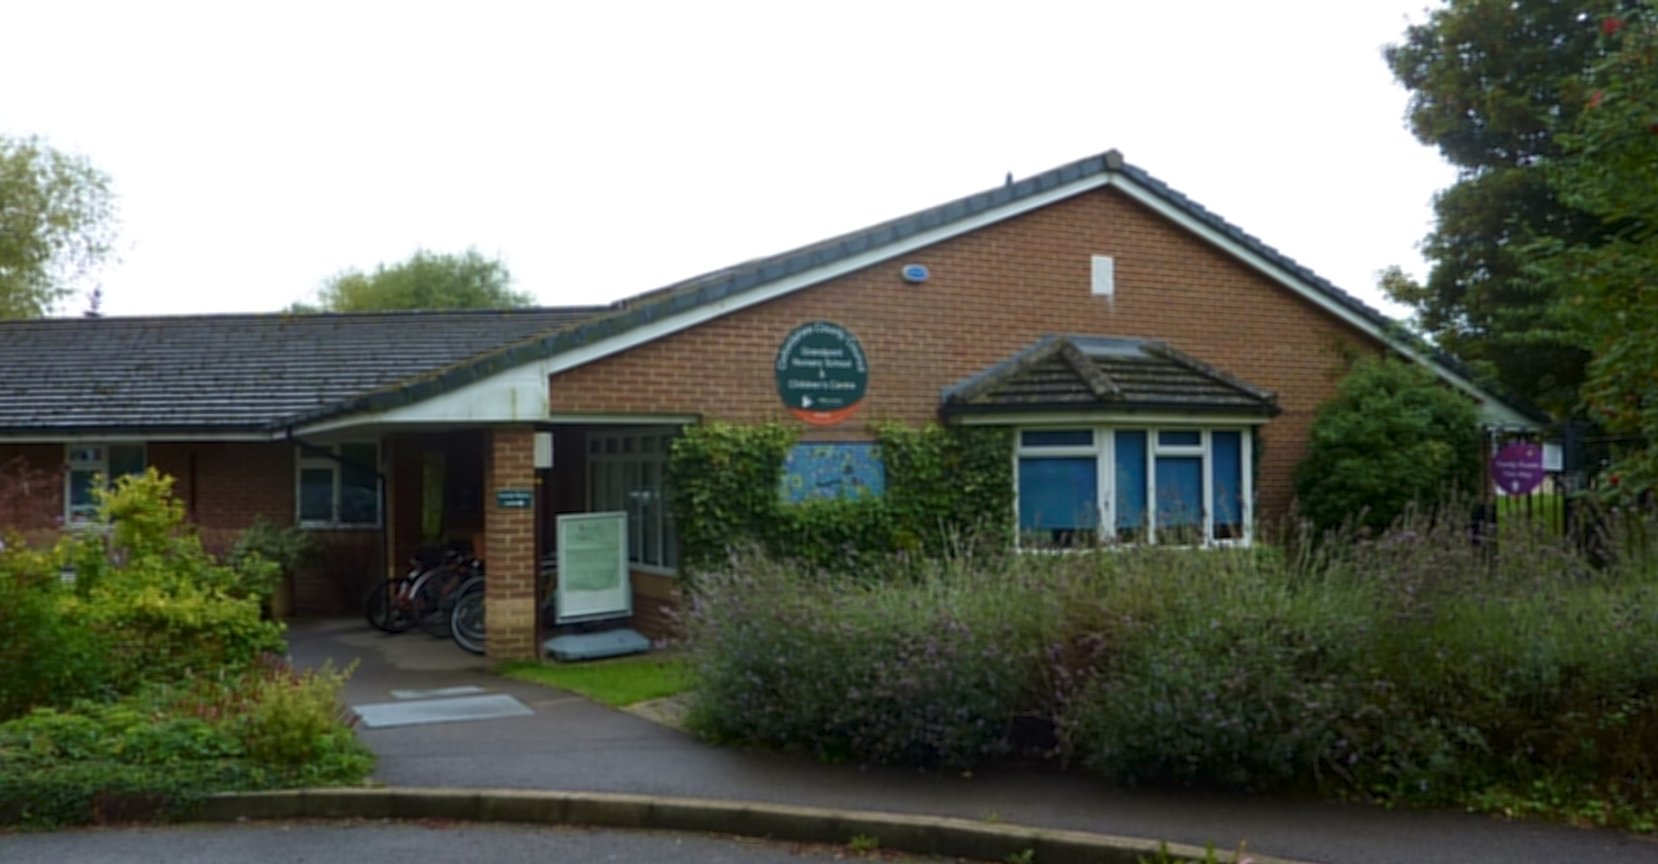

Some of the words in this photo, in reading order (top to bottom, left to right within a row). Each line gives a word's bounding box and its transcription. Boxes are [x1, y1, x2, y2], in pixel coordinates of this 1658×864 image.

[813, 323, 845, 341] County
[845, 335, 866, 373] Council
[824, 358, 852, 369] School
[829, 379, 856, 390] Centre
